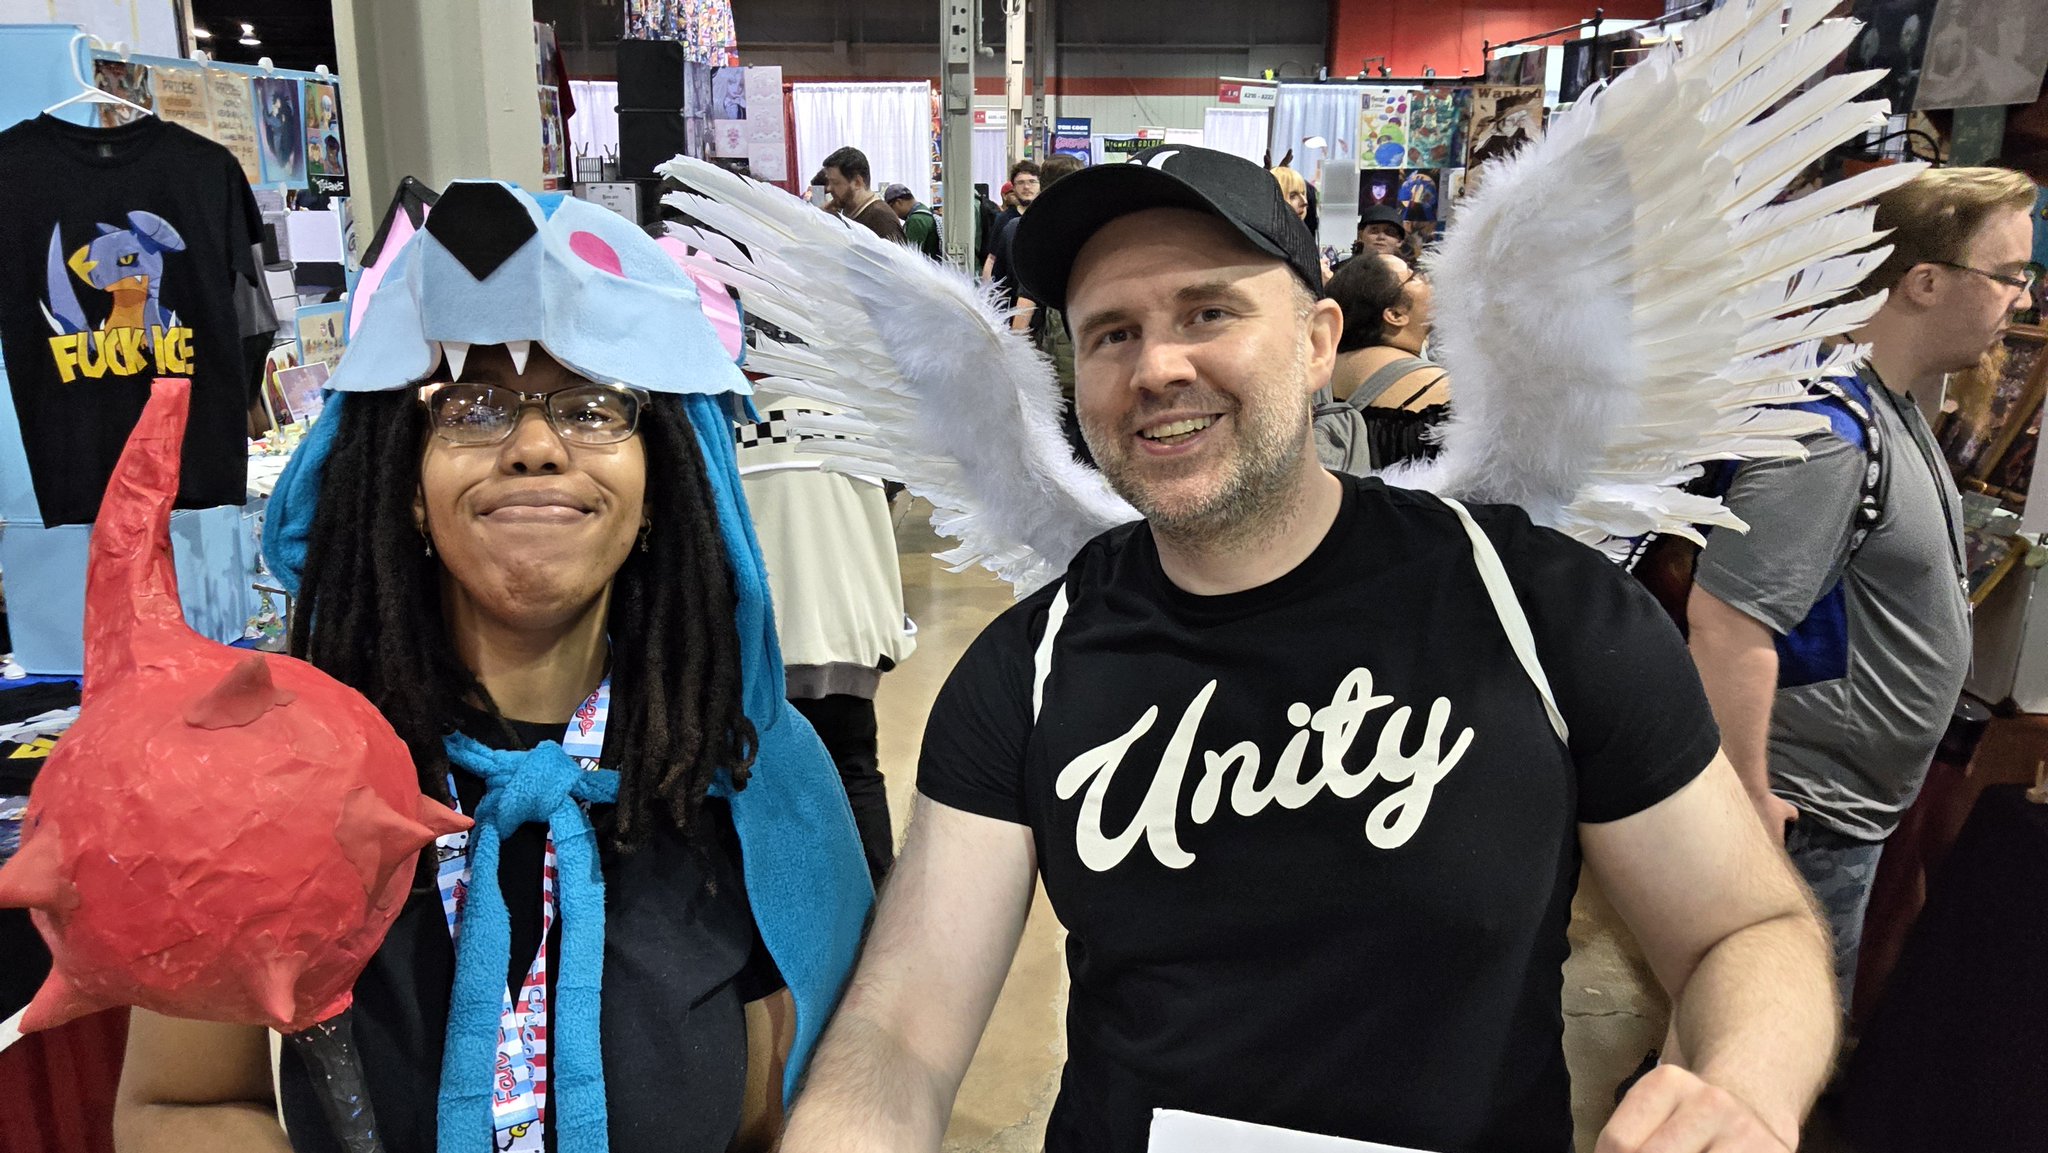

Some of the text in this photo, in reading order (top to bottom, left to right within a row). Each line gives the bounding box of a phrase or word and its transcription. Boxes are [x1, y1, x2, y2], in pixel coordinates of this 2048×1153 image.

[1105, 140, 1135, 148] MICHAEL
[49, 325, 195, 384] FUCK ICE
[1056, 667, 1475, 872] Unity
[493, 1051, 521, 1108] Fan
